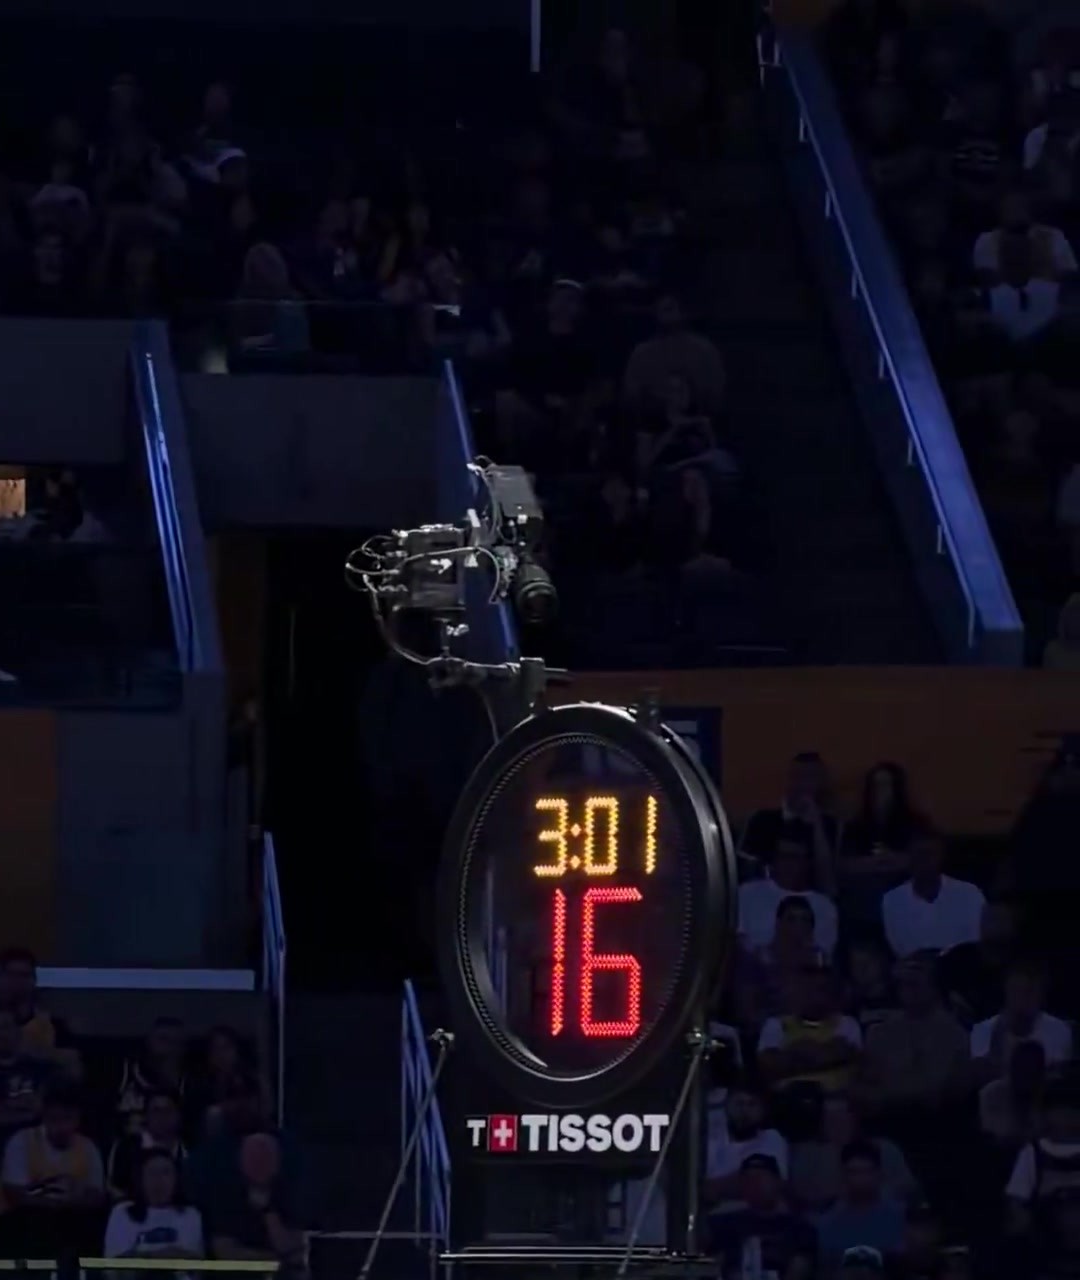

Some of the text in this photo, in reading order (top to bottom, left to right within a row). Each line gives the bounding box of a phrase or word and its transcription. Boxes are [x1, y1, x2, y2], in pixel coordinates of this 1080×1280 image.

[534, 796, 657, 877] 3:01
[550, 887, 642, 1036] 16
[521, 1114, 670, 1152] TISSOT
